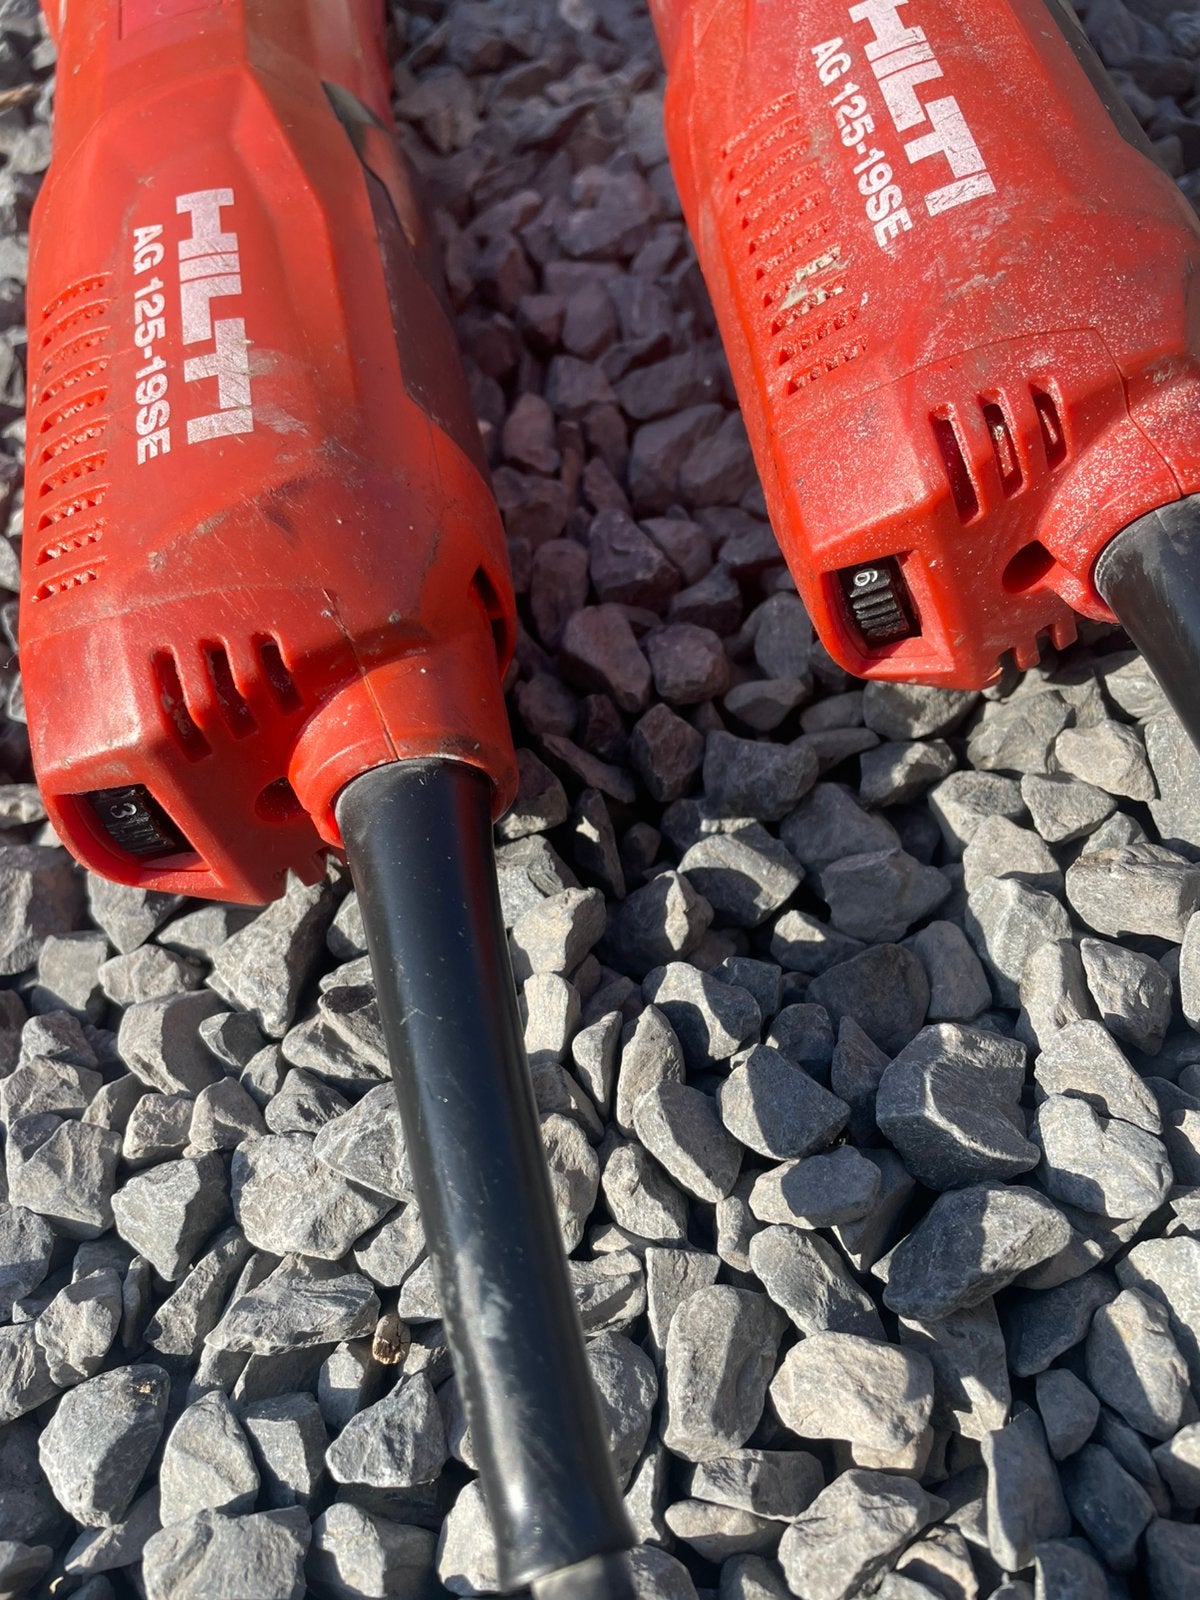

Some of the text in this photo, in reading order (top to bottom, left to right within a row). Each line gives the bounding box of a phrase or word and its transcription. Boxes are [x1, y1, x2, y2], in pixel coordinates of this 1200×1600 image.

[811, 36, 913, 248] AG 125-19SE
[848, 0, 997, 217] HILTI
[133, 223, 172, 466] AG 125-19SE
[175, 187, 254, 446] HILTI
[854, 570, 879, 587] 6
[109, 802, 138, 819] 3
